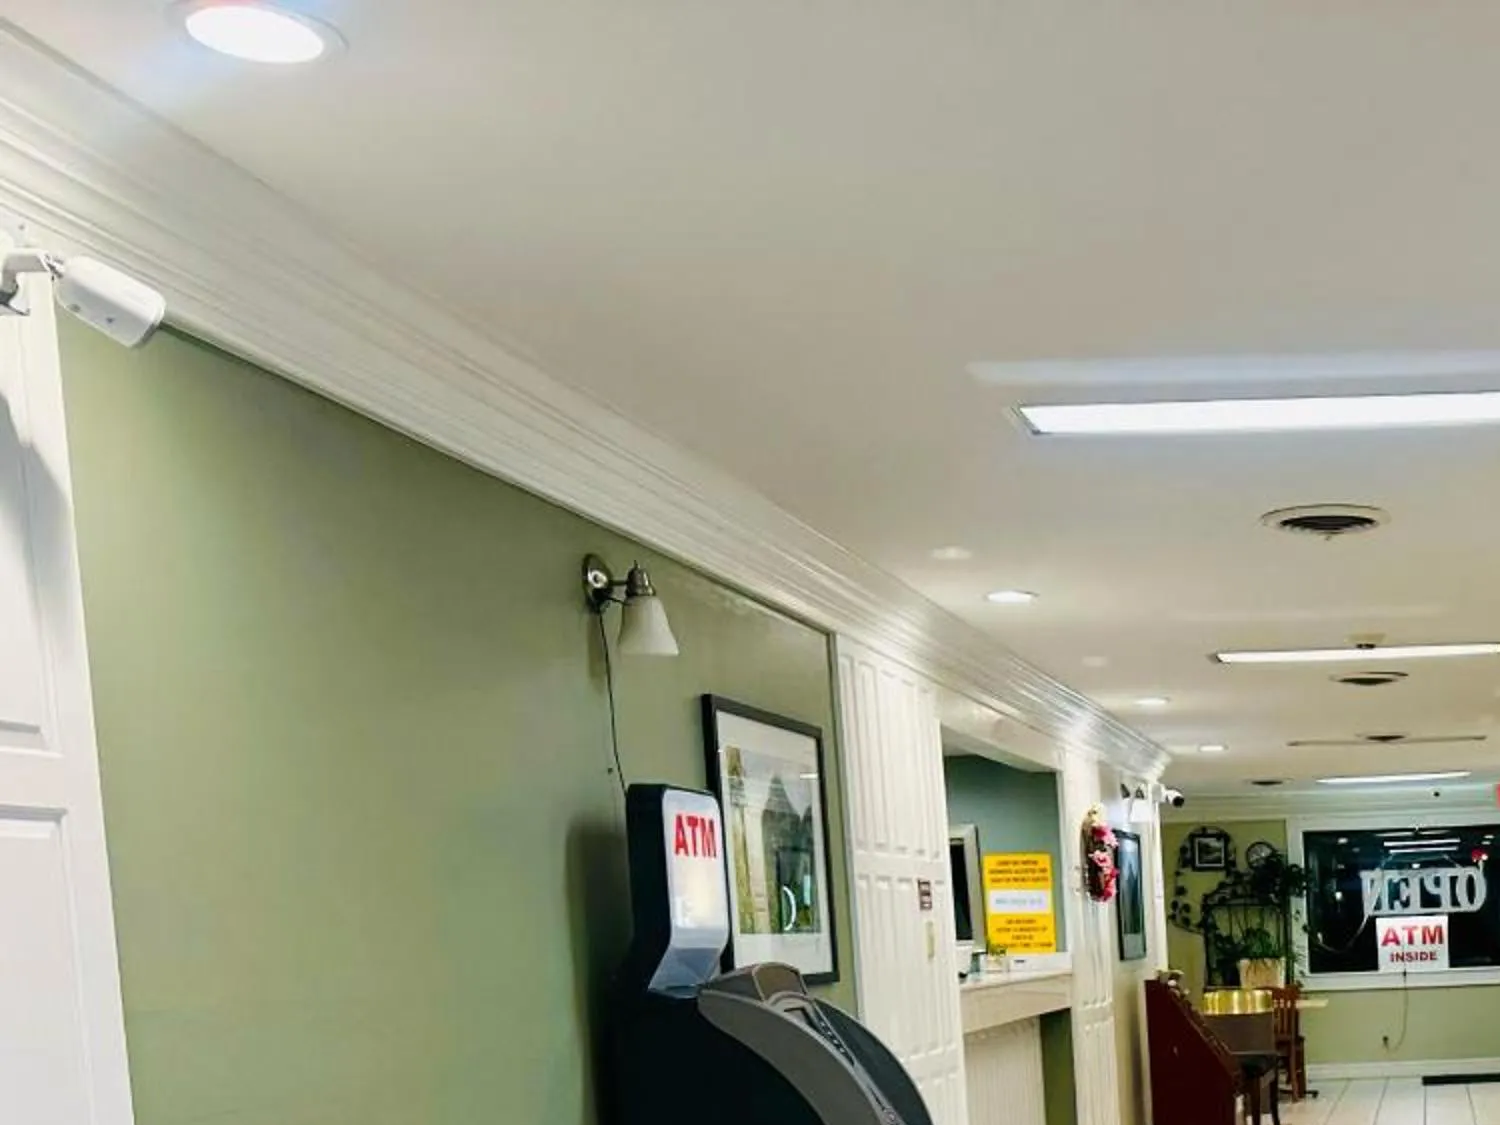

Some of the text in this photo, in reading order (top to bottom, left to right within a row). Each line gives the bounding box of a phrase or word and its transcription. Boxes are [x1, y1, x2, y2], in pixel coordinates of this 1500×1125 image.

[674, 813, 717, 858] ATM
[1381, 925, 1444, 946] ATM
[1390, 951, 1437, 962] INSIDE
